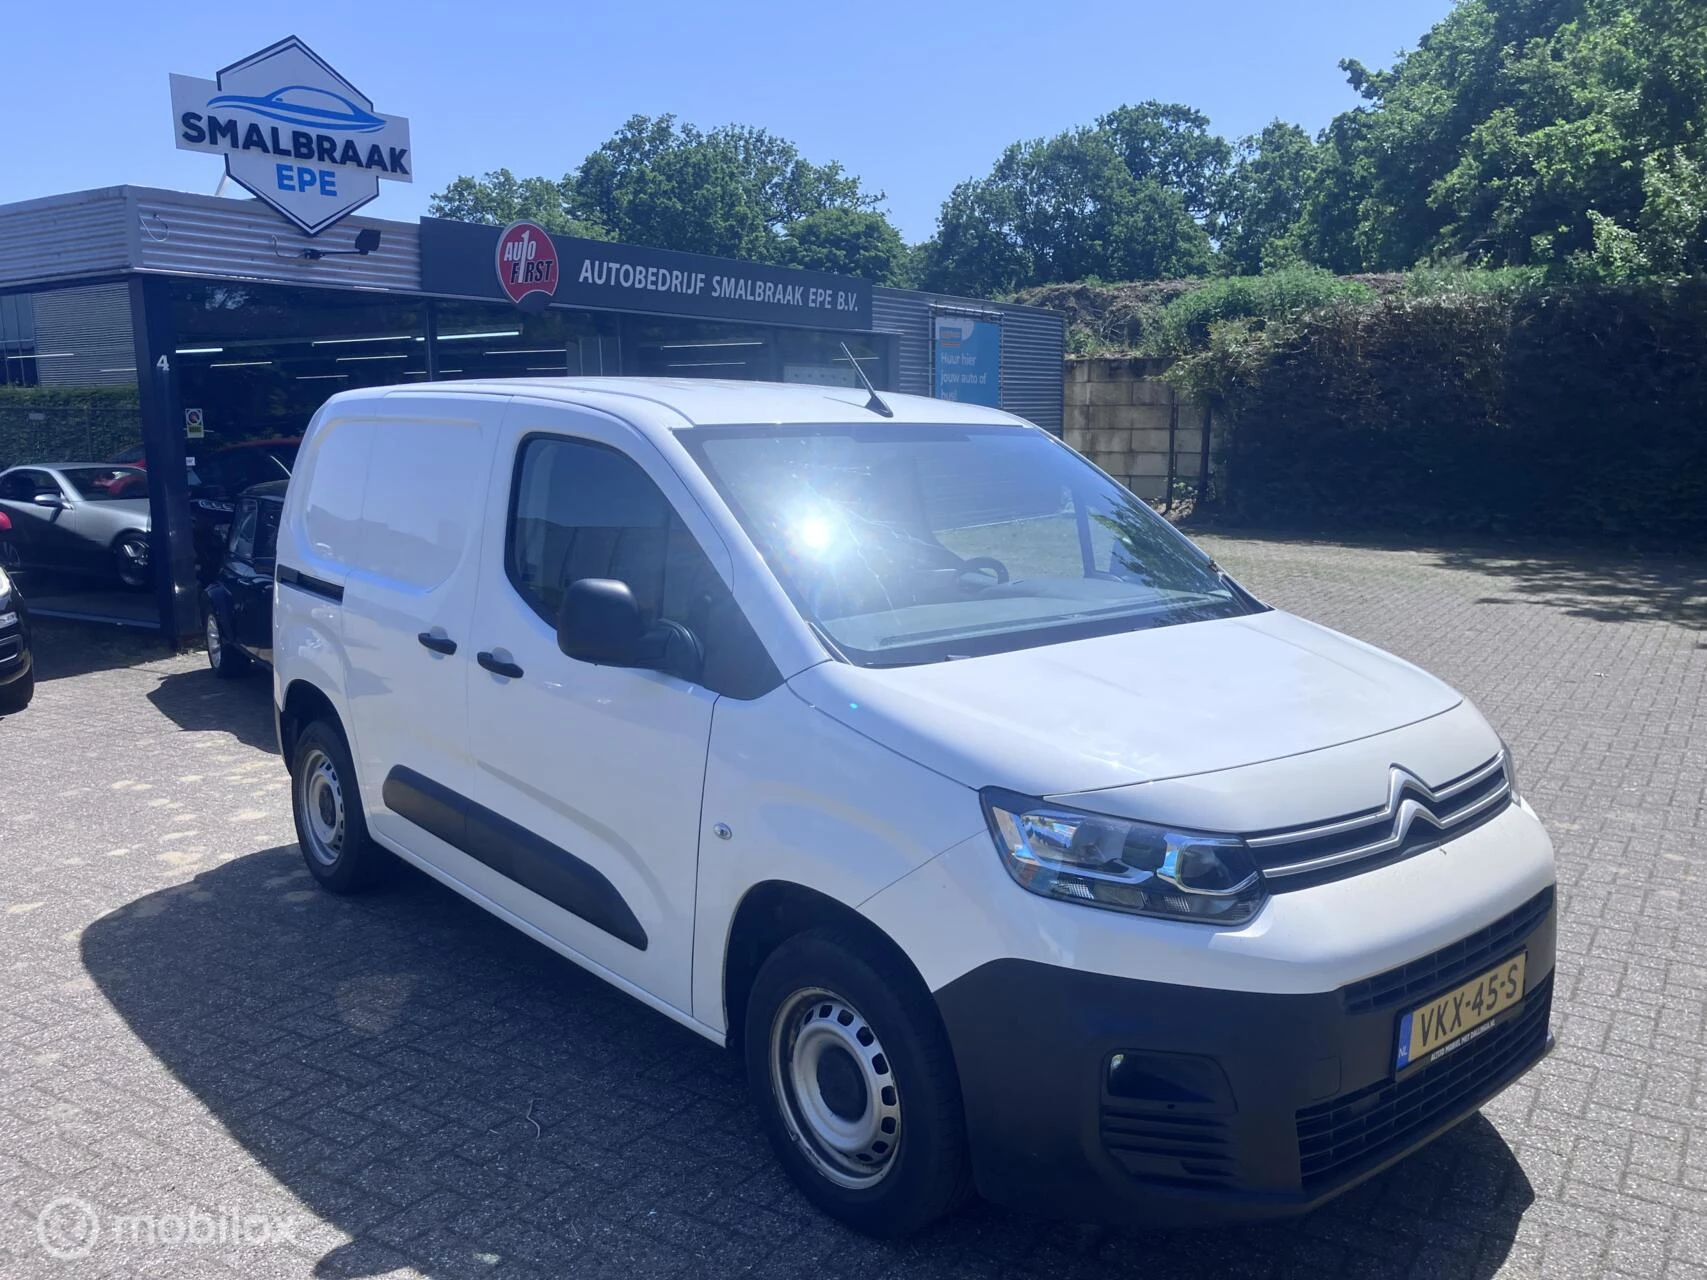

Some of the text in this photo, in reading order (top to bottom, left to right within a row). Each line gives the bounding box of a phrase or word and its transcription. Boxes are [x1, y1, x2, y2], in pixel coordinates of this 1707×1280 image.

[181, 111, 410, 175] SMALBRAAK
[276, 163, 338, 197] EPE
[578, 259, 858, 312] AUTOBEDRIJF SMALBRAAK EPE B.V.
[156, 354, 170, 371] 4
[1420, 963, 1519, 1048] VKX-45-S
[1399, 1045, 1408, 1059] NL
